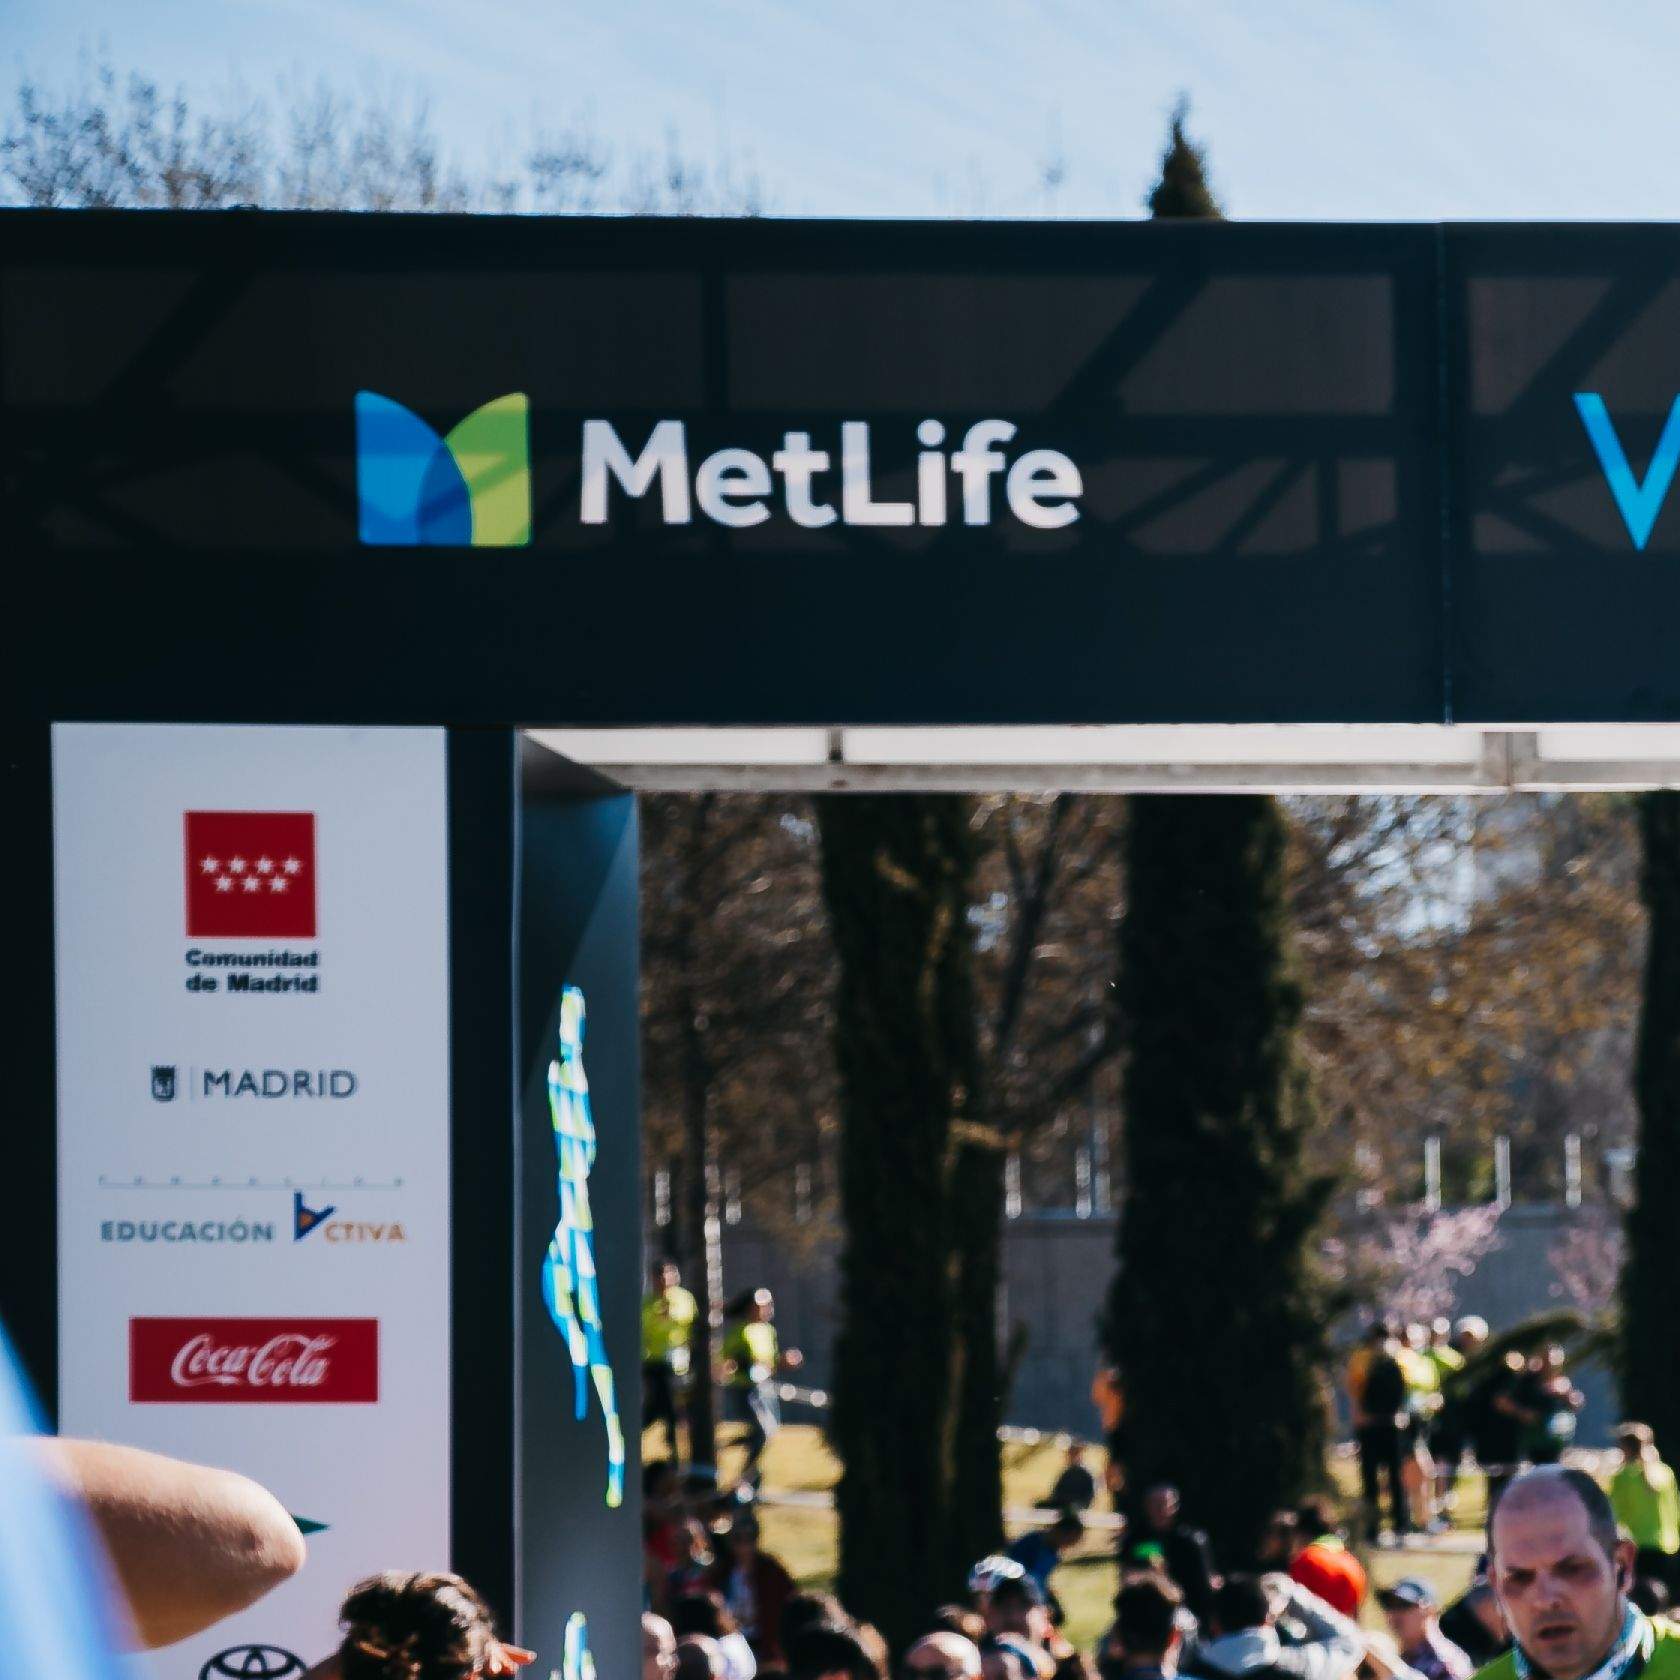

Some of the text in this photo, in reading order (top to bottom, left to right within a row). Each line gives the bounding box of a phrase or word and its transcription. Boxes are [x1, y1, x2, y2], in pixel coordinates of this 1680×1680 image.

[580, 419, 1083, 529] MetLife
[185, 948, 319, 969] Comunidad
[185, 973, 319, 993] de Madrid
[203, 1070, 358, 1098] MADRID
[101, 1212, 273, 1242] EDUCACIÓN
